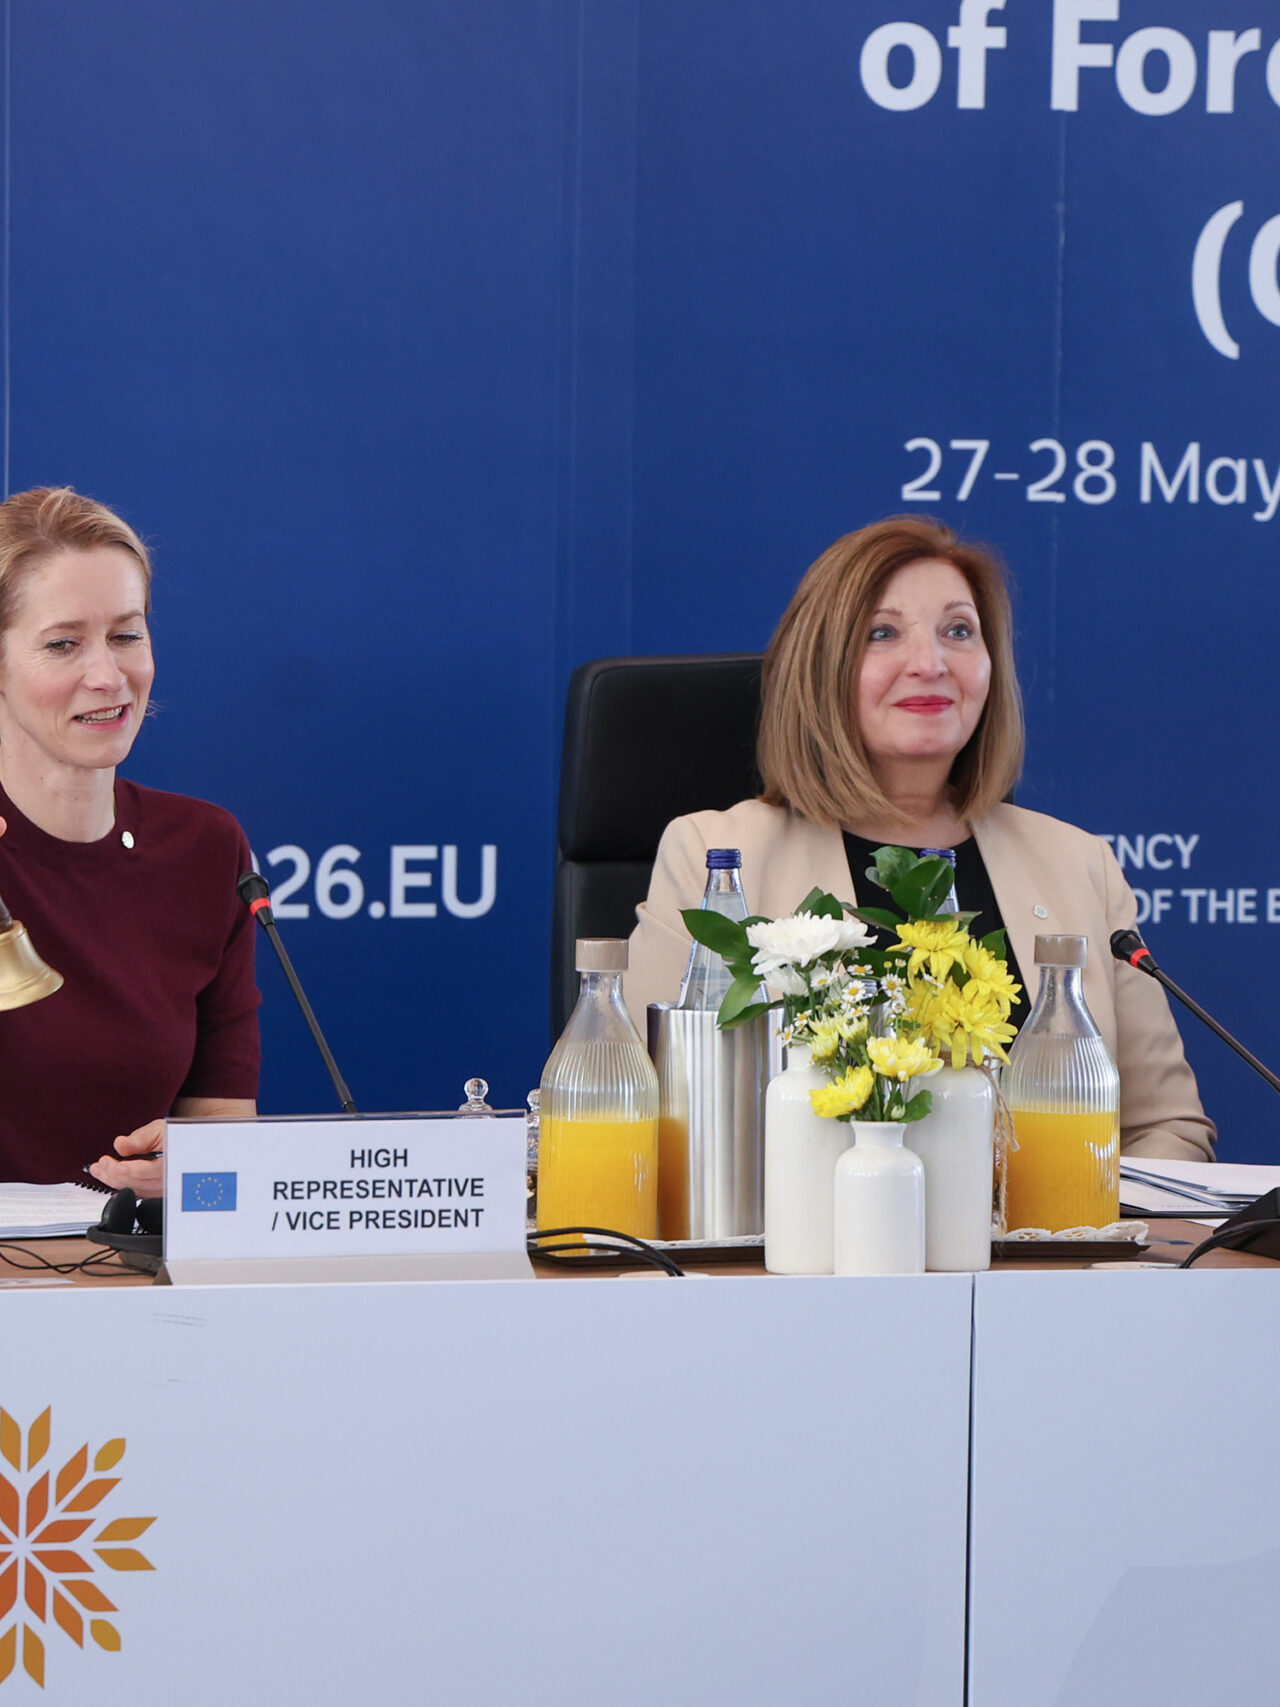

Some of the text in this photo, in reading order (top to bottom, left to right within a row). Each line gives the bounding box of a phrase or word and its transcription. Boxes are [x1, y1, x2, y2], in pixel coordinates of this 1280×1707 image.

[859, 0, 1280, 116] of For
[901, 438, 1280, 522] 27-28 May
[1096, 834, 1200, 870] NCY
[250, 844, 497, 919] 26.EU
[1180, 888, 1257, 924] THE
[350, 1148, 408, 1168] HIGH
[273, 1177, 485, 1200] REPRESENTATIVE
[286, 1210, 340, 1231] VICE
[349, 1208, 485, 1230] PRESIDENT
